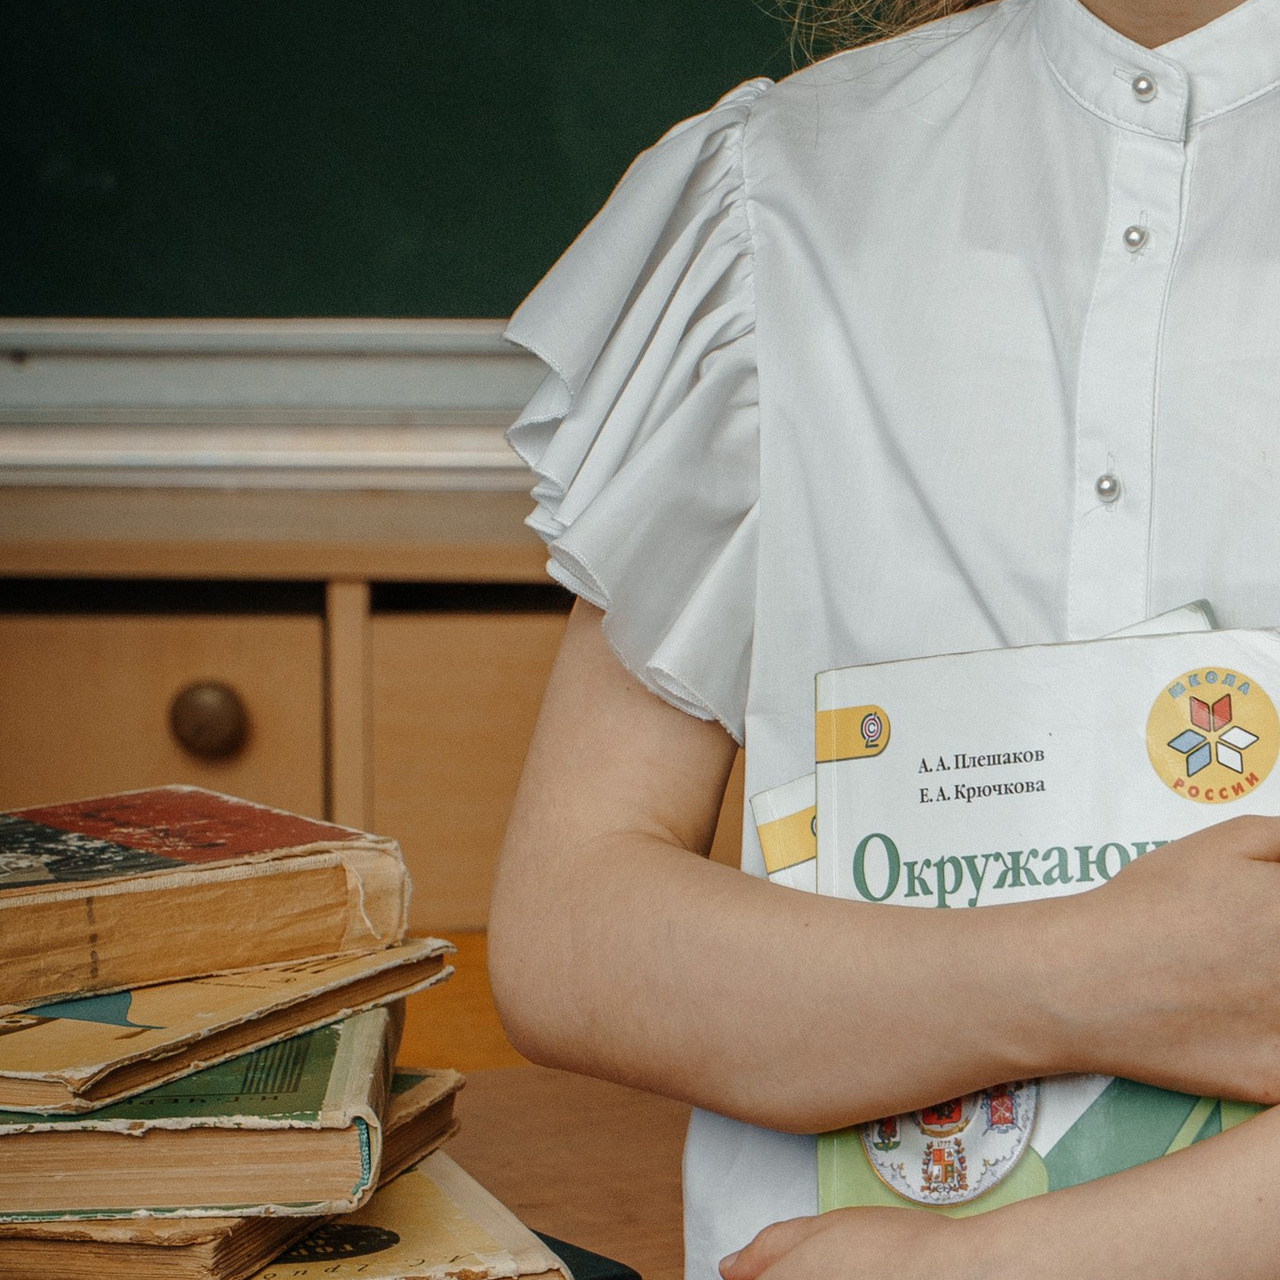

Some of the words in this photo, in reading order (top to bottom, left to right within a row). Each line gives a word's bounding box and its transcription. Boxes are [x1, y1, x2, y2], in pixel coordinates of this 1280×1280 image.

[1167, 670, 1251, 699] ШКОЛА
[917, 757, 933, 774] А.
[935, 755, 951, 772] А.
[953, 748, 1045, 771] Плешаков
[919, 787, 933, 804] Е.
[936, 785, 951, 802] А.
[953, 779, 1046, 804] Крючкова
[1172, 772, 1260, 801] РОССИИ
[852, 832, 1176, 909] Окружаю
